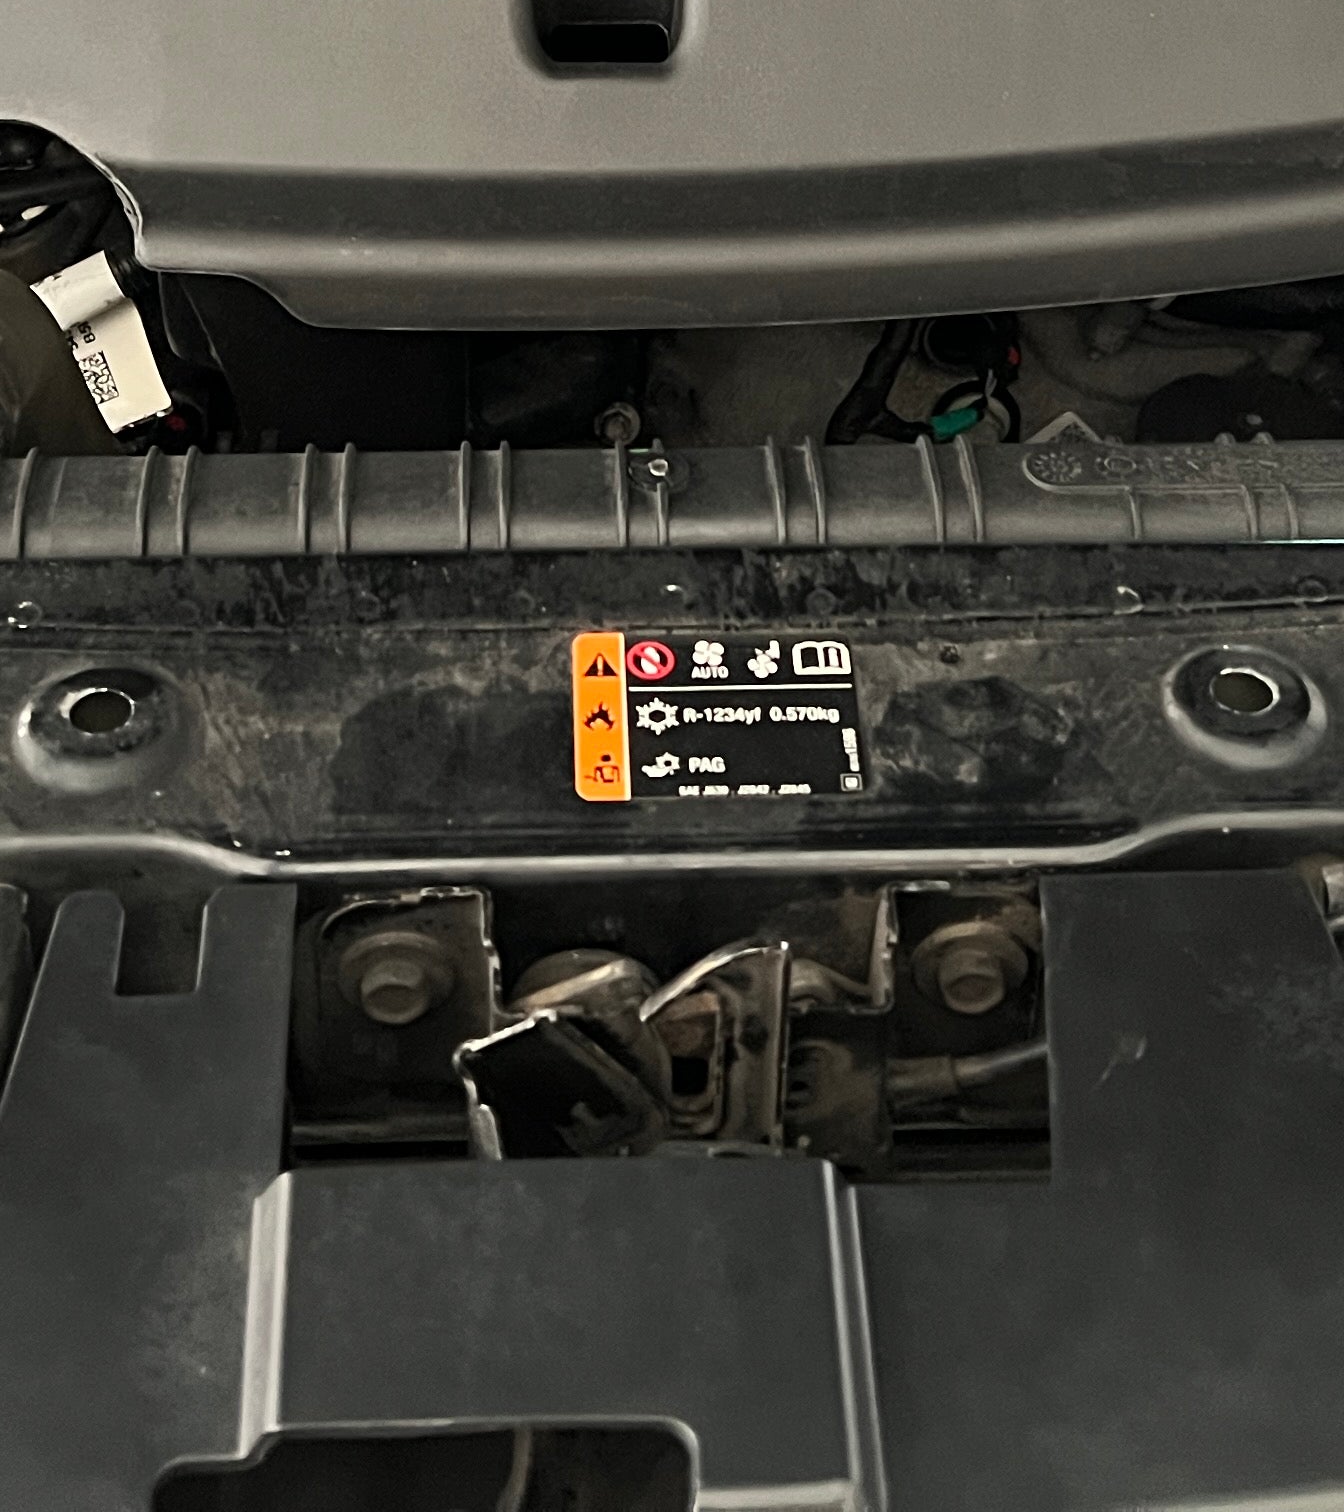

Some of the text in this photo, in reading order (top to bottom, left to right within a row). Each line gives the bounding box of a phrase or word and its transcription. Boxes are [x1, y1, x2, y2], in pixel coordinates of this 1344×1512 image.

[691, 665, 729, 679] AUTO
[682, 706, 840, 725] R-1234yf 0.570kg
[688, 756, 726, 773] PAG
